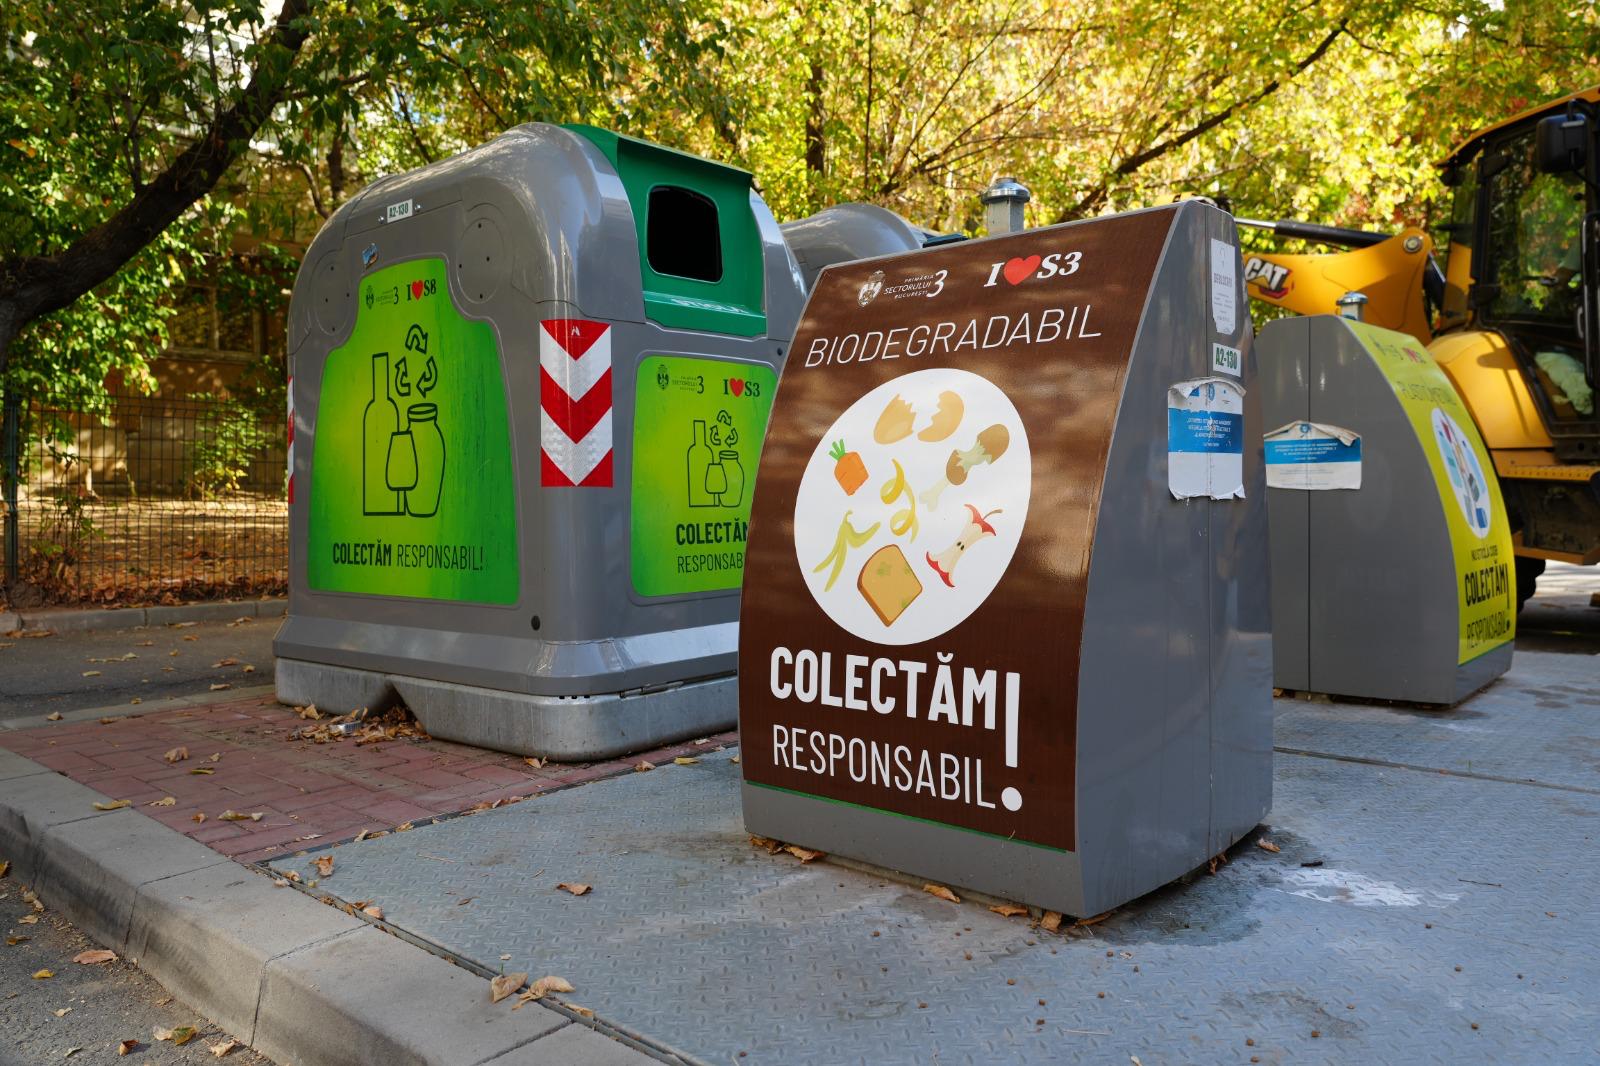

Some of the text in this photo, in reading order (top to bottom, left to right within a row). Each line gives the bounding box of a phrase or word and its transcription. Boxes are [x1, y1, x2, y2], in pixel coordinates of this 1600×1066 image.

[926, 269, 948, 298] 3
[974, 251, 1083, 288] I S3
[1245, 257, 1289, 291] CAT
[407, 284, 411, 301] I
[804, 304, 1102, 368] BIODEGRADABIL
[1215, 347, 1238, 370] A2-130
[697, 375, 705, 394] 3
[723, 379, 729, 395] I
[744, 381, 760, 397] S3
[332, 538, 483, 571] COLECTĂM RESPONSABIL!
[770, 646, 997, 730] COLECTĂM
